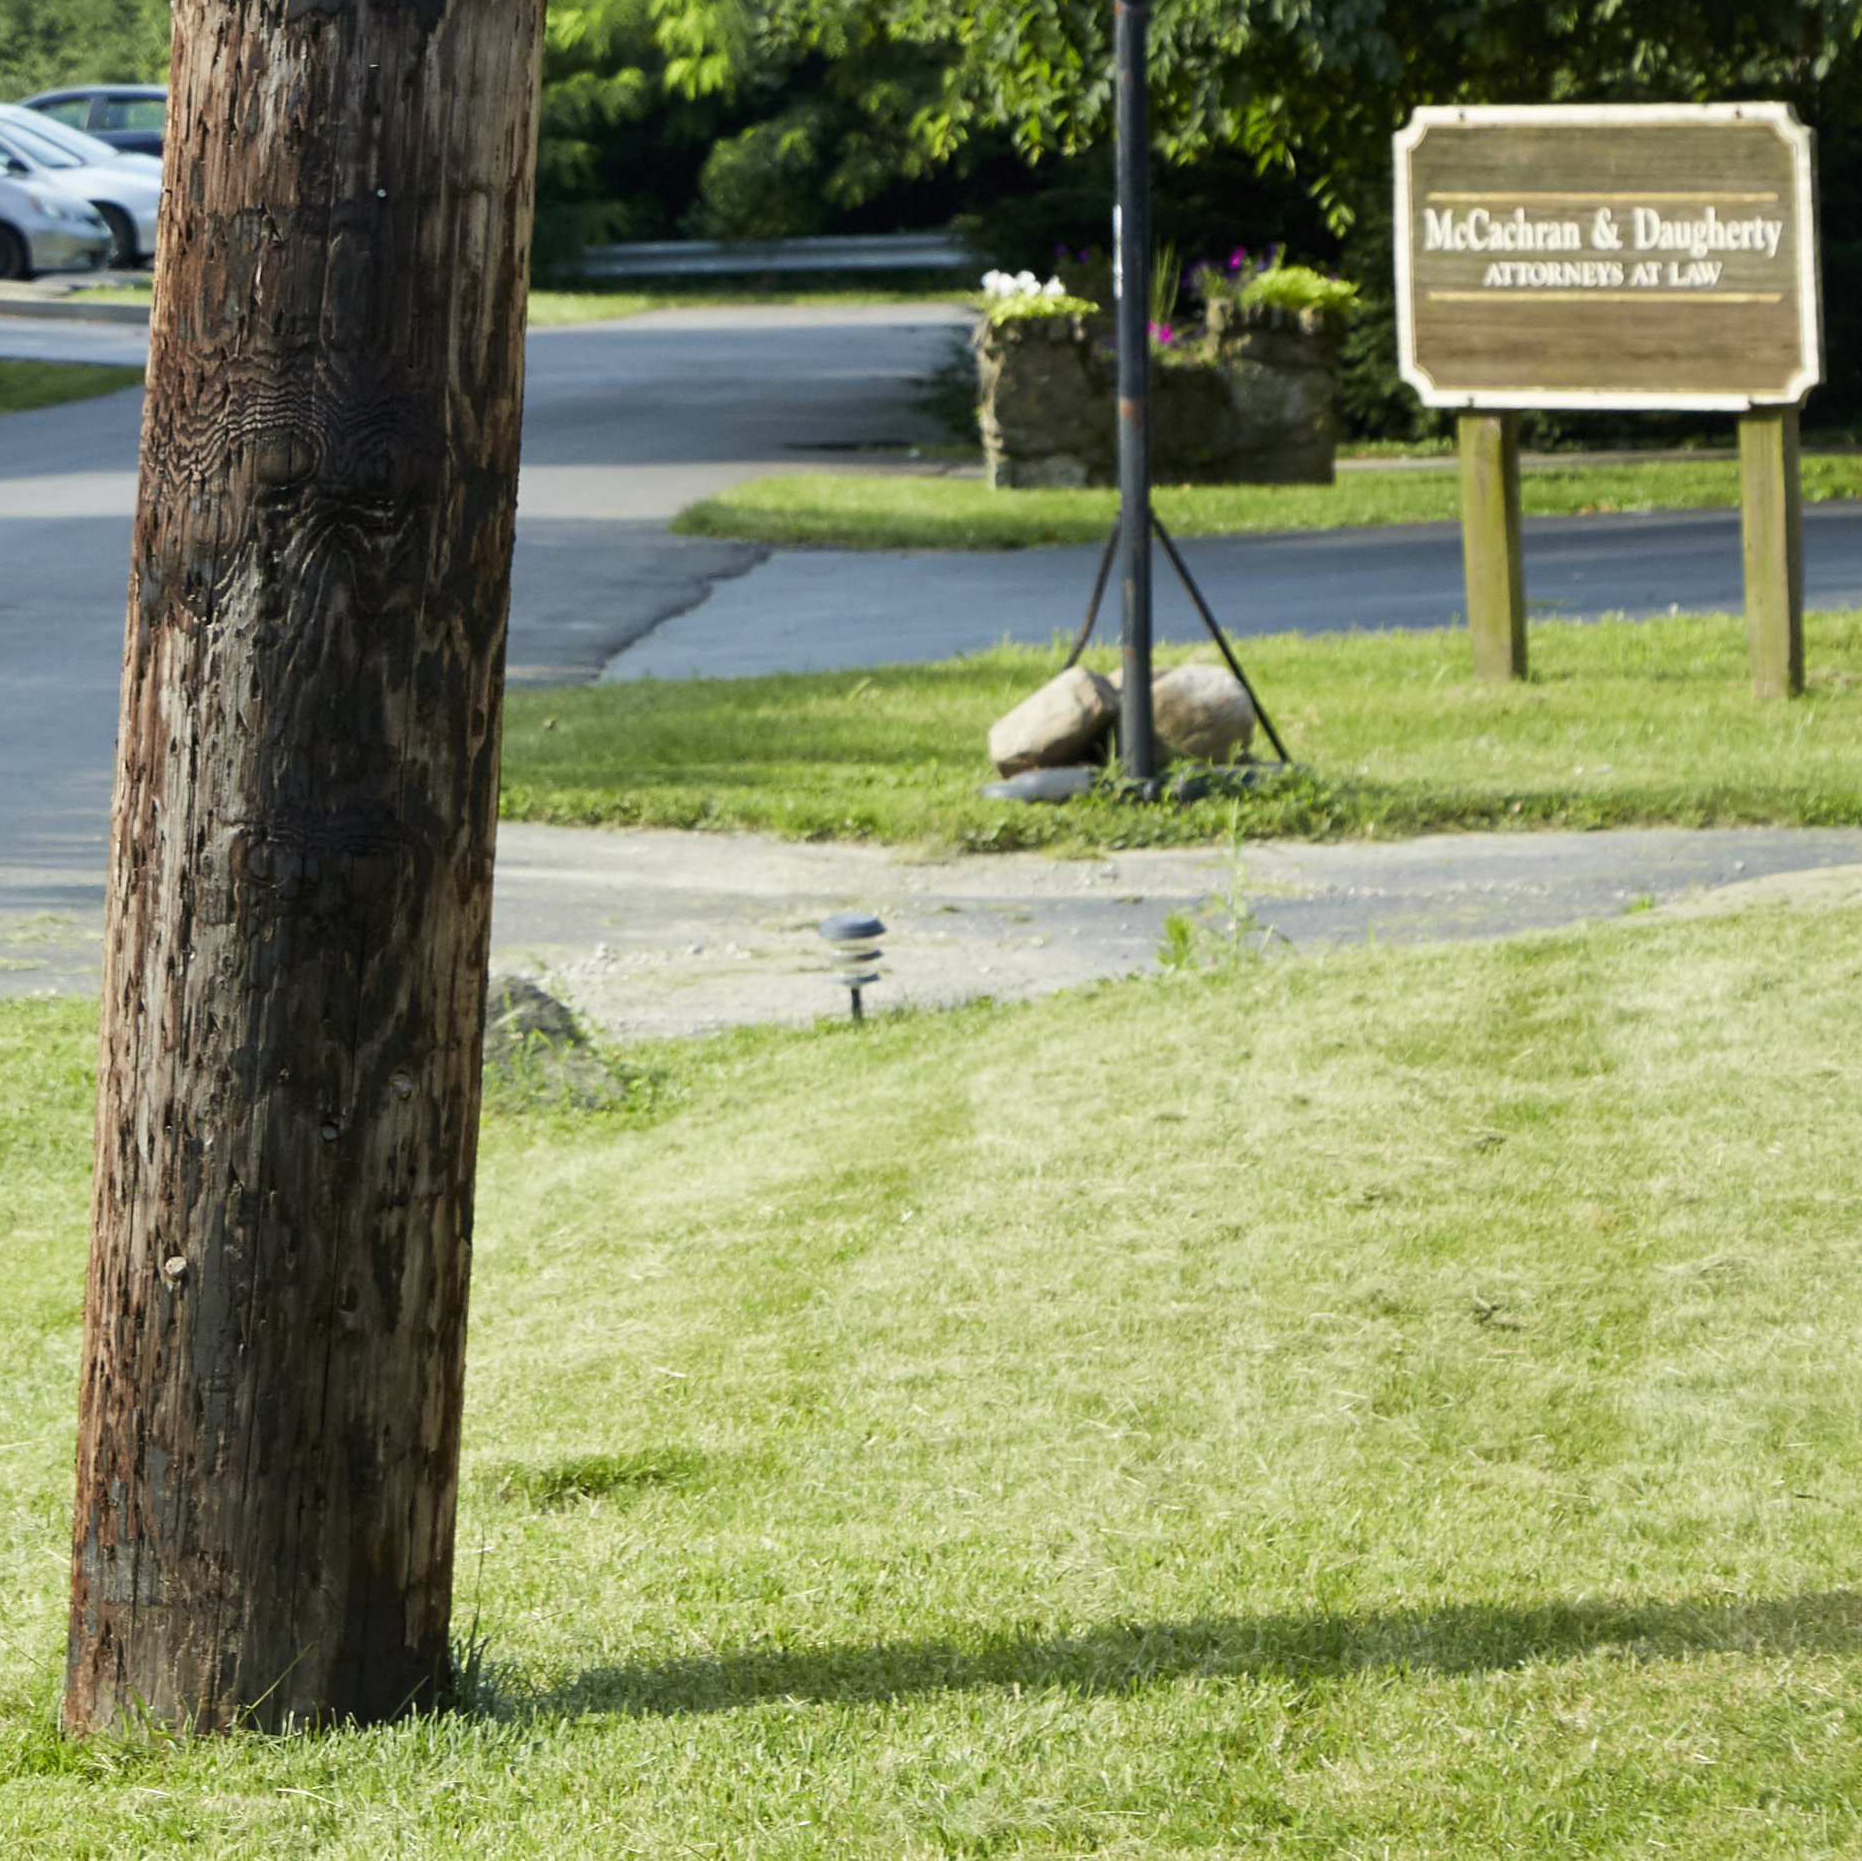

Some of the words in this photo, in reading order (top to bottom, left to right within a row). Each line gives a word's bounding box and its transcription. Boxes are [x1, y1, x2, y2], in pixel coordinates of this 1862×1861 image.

[1423, 206, 1581, 251] McCachran
[1591, 206, 1624, 251] &
[1632, 206, 1783, 259] Daugherty
[1482, 260, 1624, 287] ATTORNEYS
[1628, 261, 1663, 287] AT
[1668, 260, 1723, 287] LAW
